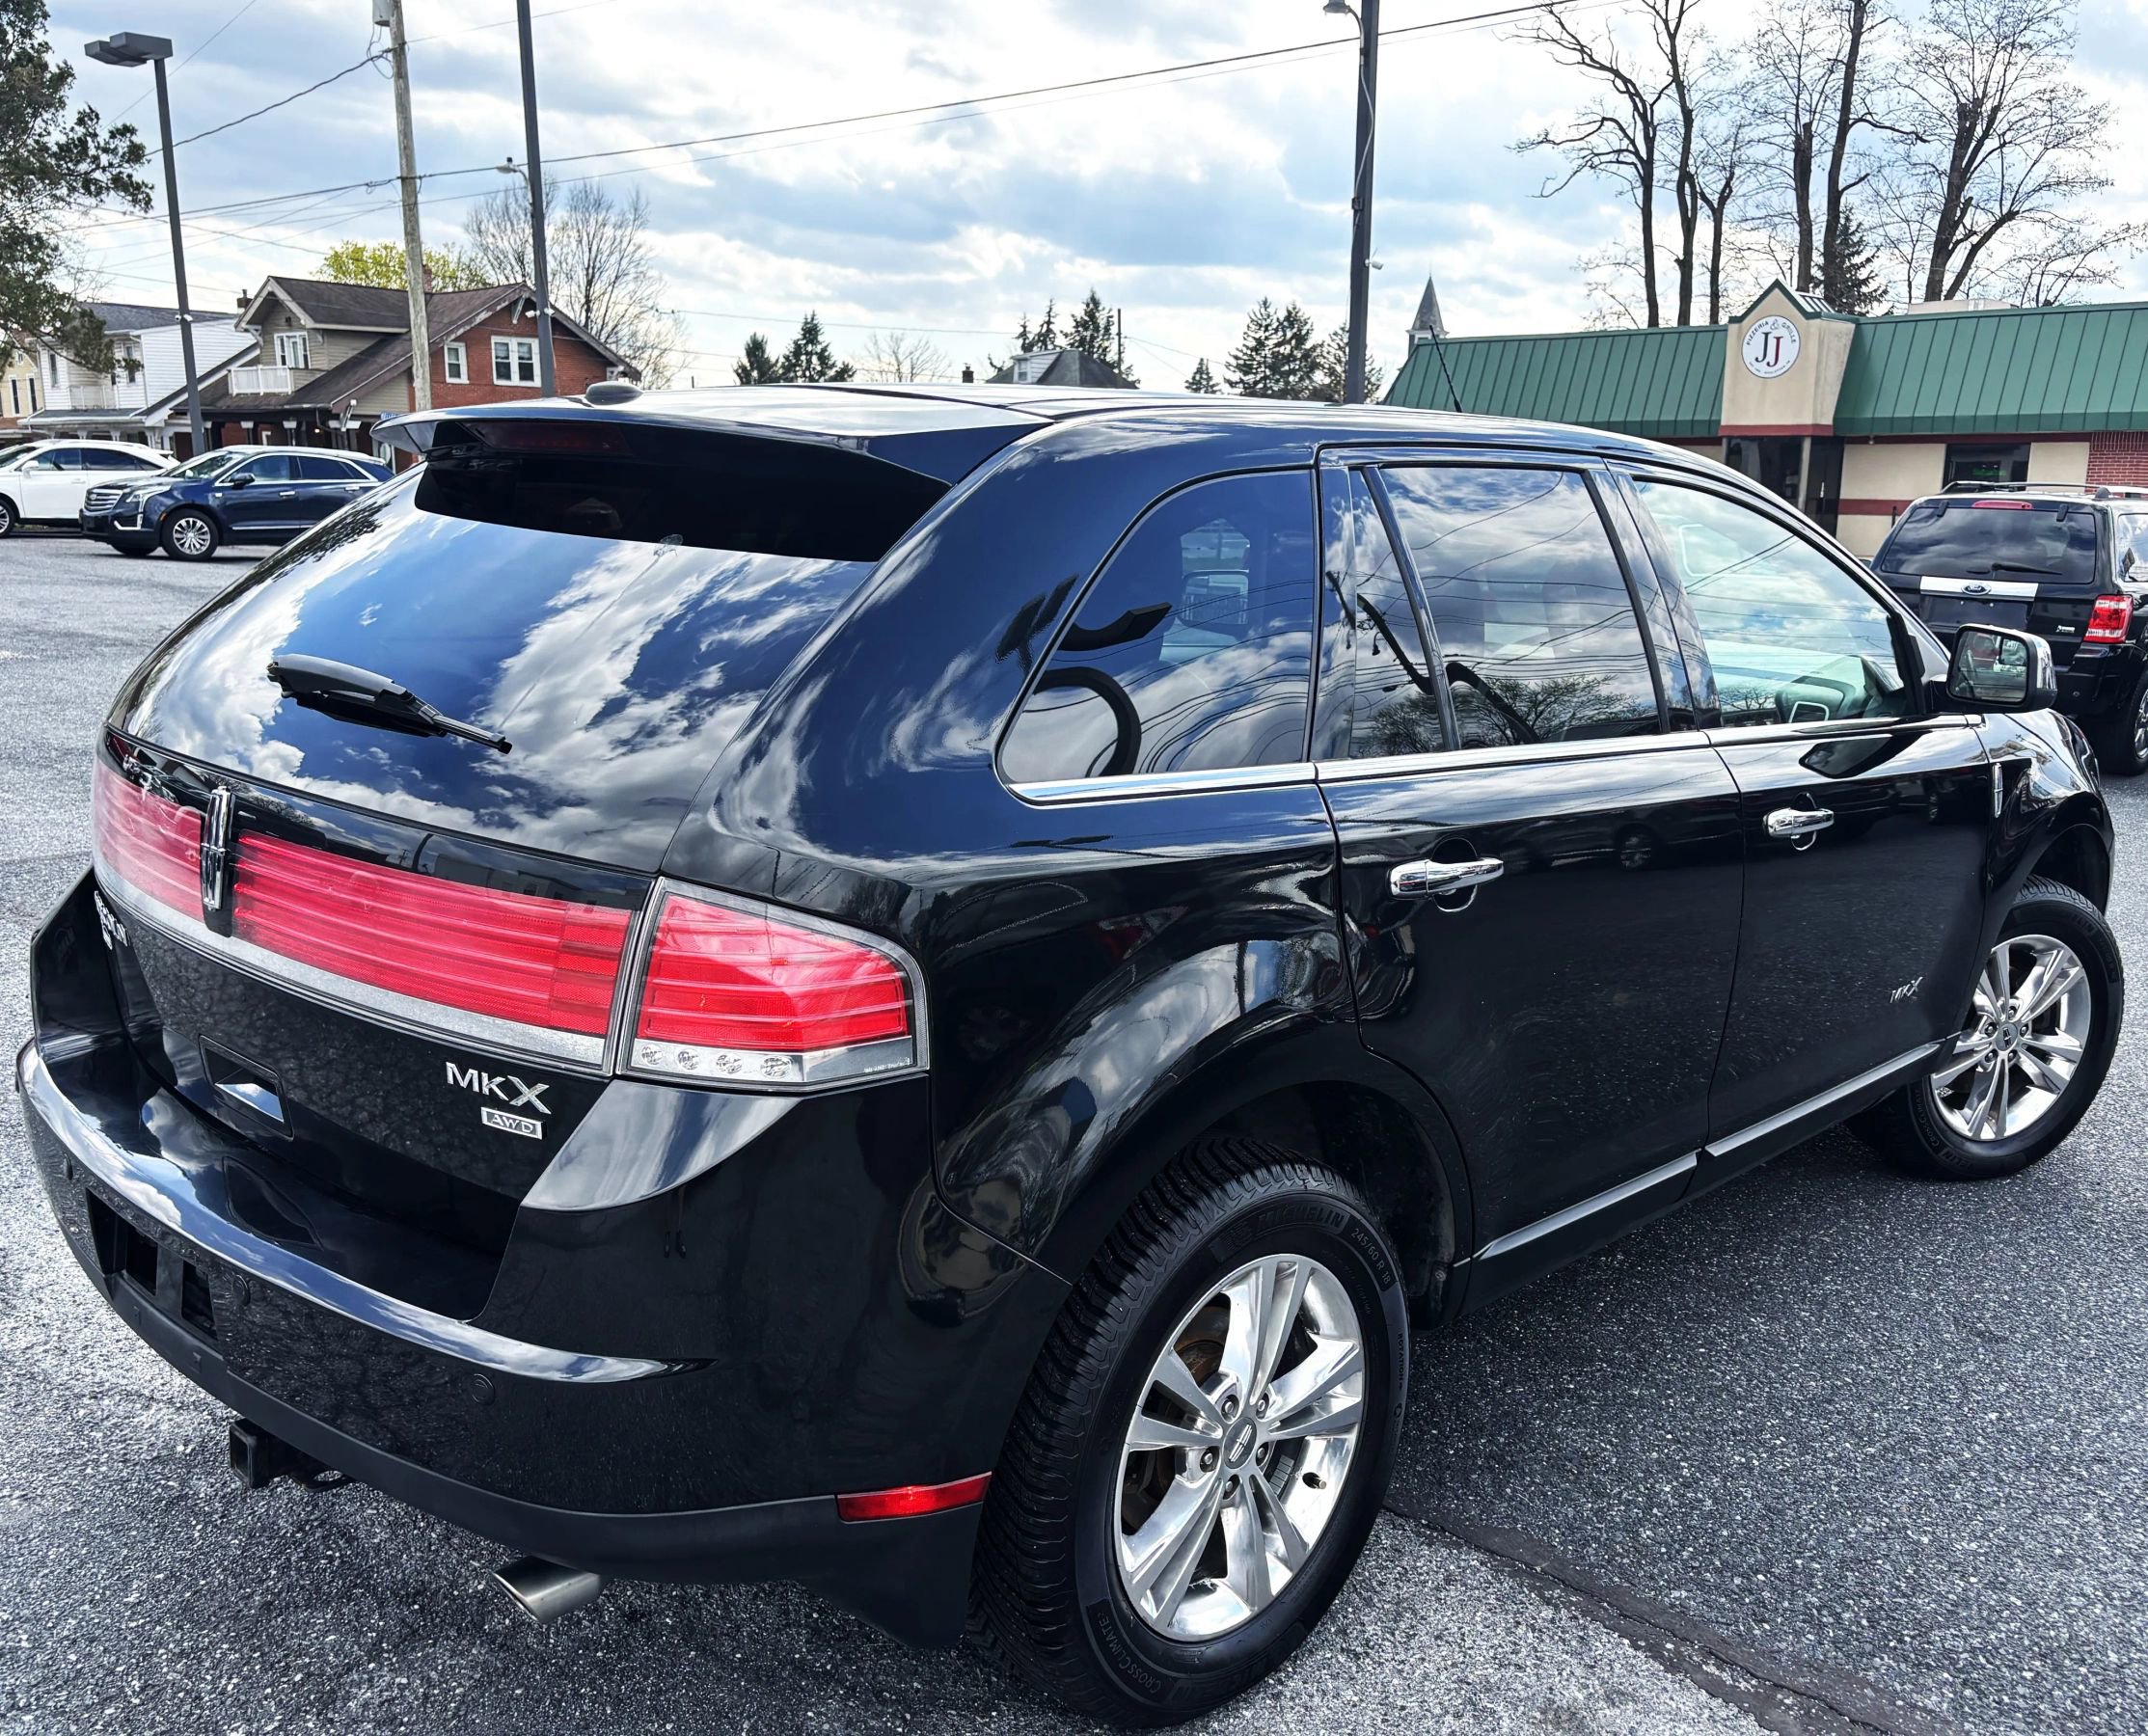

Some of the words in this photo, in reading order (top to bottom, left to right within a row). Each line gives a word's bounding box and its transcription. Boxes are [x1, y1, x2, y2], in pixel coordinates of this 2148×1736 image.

[1746, 320, 1769, 346] PIZZERIA
[1890, 976, 1924, 1004] MKX
[490, 1114, 533, 1133] AWD
[1350, 1228, 1379, 1260] 245/60
[1375, 1261, 1385, 1271] R
[1381, 1271, 1391, 1285] 18
